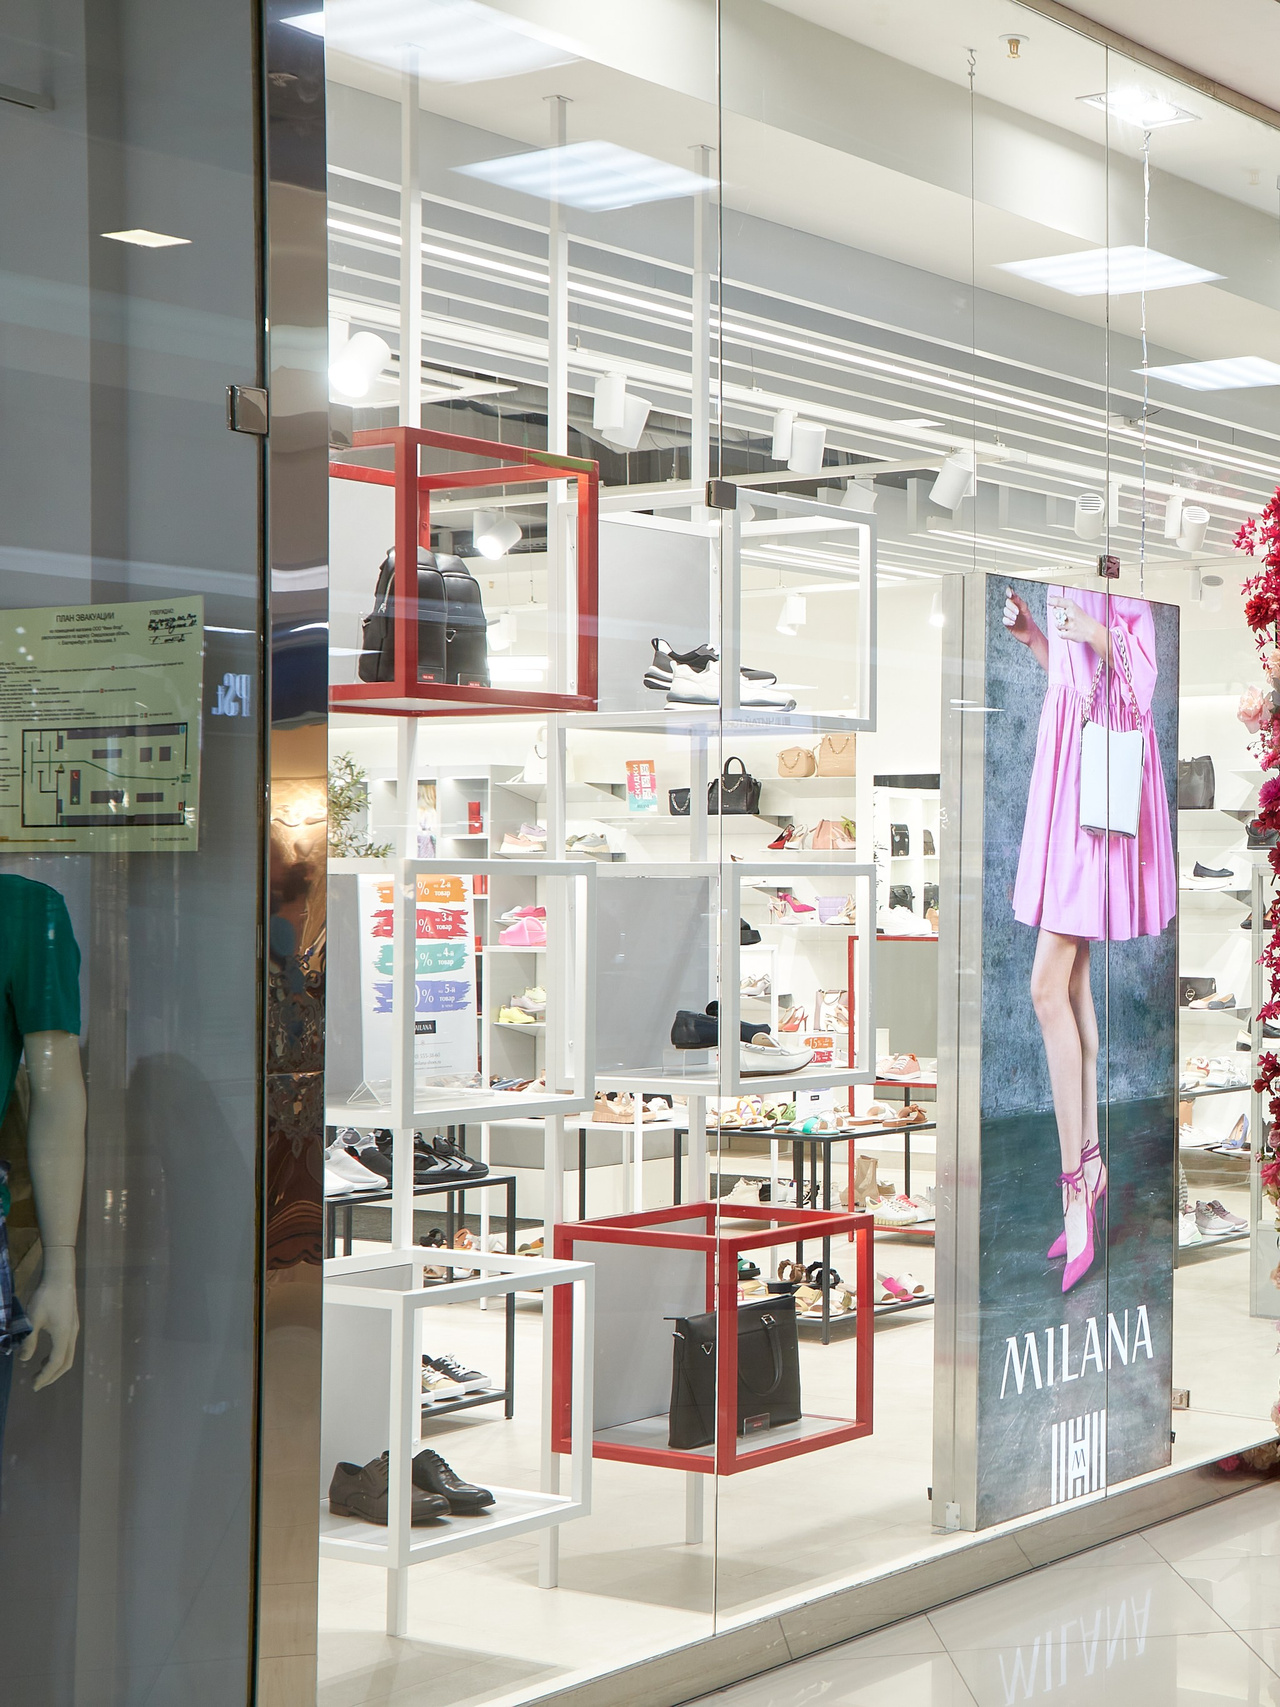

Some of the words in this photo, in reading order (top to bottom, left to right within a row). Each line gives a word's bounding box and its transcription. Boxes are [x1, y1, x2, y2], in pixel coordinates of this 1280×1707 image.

[56, 614, 75, 623] ПЛАН
[76, 612, 115, 622] ЭВАКУАЦИИ
[434, 890, 451, 898] товар
[436, 924, 453, 932] товар
[438, 959, 455, 967] товар
[1000, 1304, 1154, 1400] MILANA
